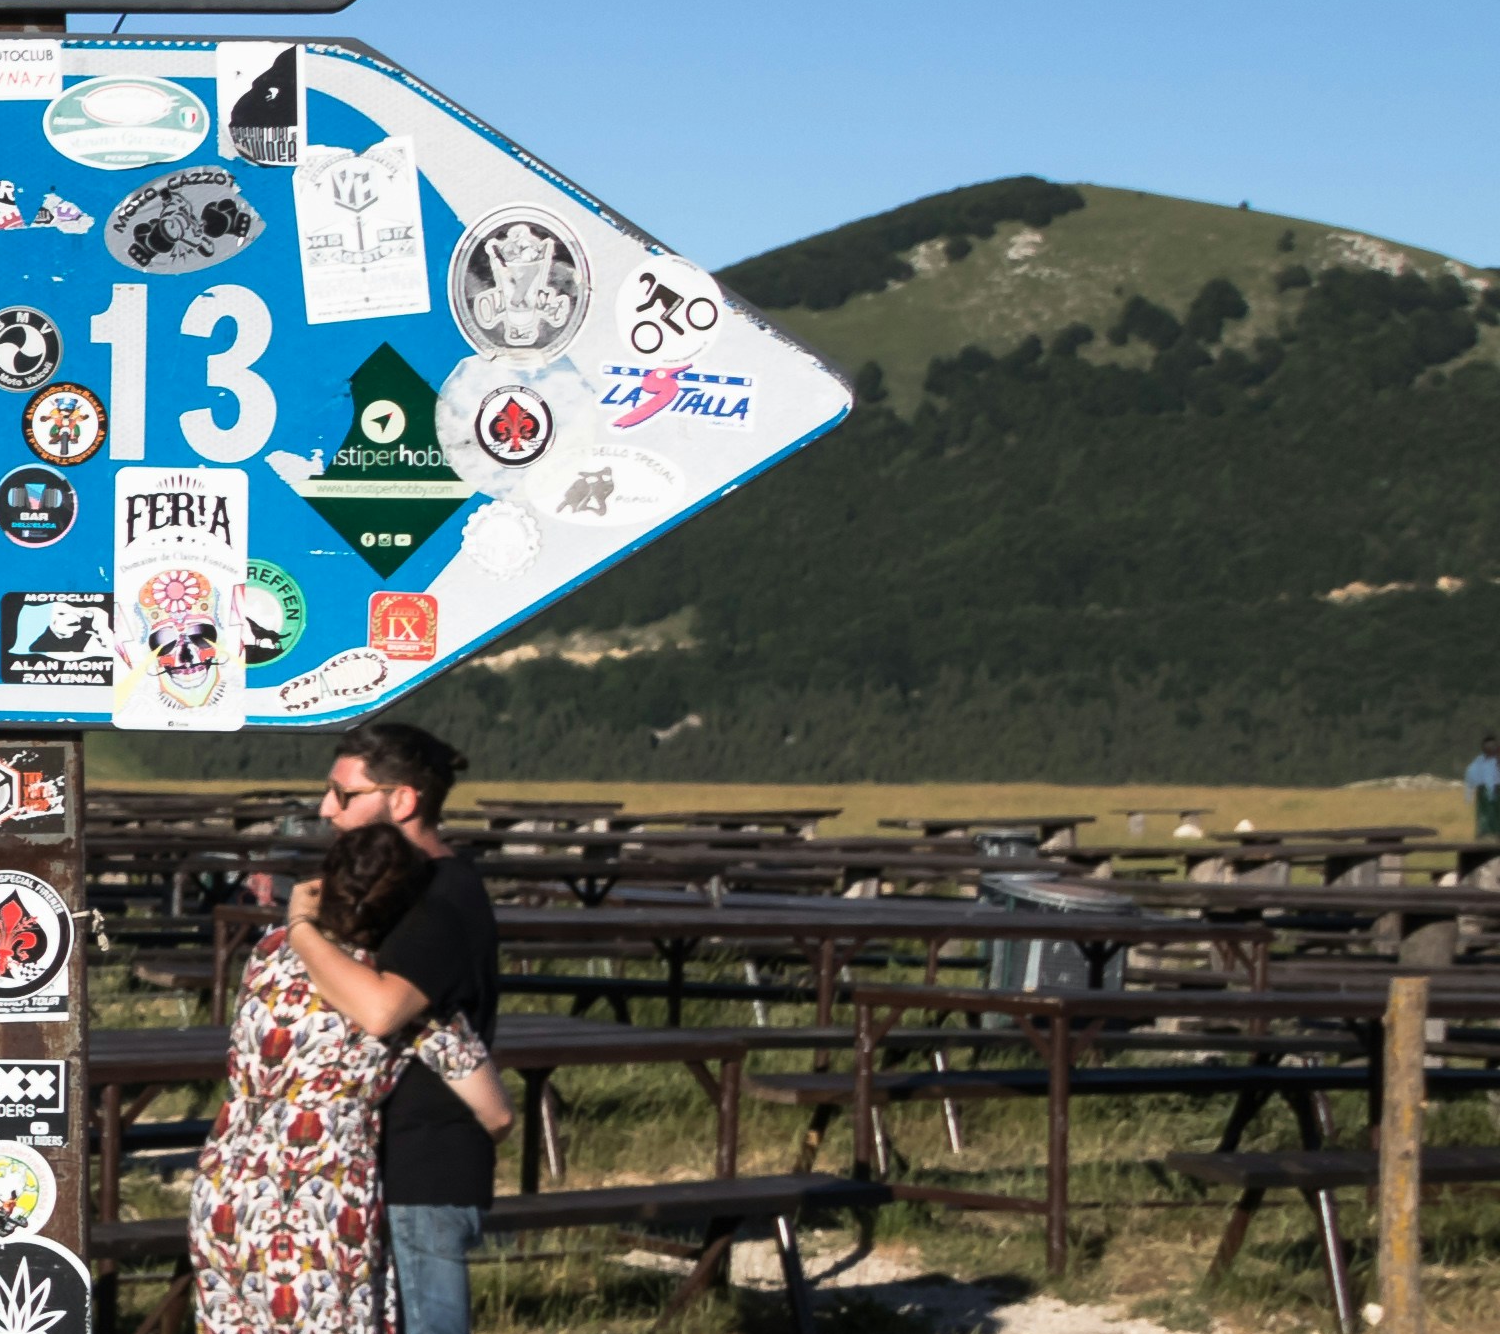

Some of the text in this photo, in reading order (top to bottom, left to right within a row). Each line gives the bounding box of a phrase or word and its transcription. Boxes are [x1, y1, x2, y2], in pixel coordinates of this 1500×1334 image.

[112, 187, 158, 234] MOTO
[0, 372, 23, 388] Moto
[26, 361, 54, 386] Veicoli
[90, 283, 278, 464] 13
[600, 384, 642, 408] LA
[316, 483, 455, 497] www.turistiperhobby.com
[20, 512, 49, 522] BAR
[120, 553, 170, 574] Domaine de
[24, 594, 104, 602] MOTOCLUB
[389, 607, 420, 616] LEGIO
[387, 616, 419, 641] IX
[10, 661, 59, 671] ALAN
[22, 674, 105, 684] RAVENNA
[0, 874, 34, 888] SPECIAL
[35, 881, 64, 915] FIRENZE
